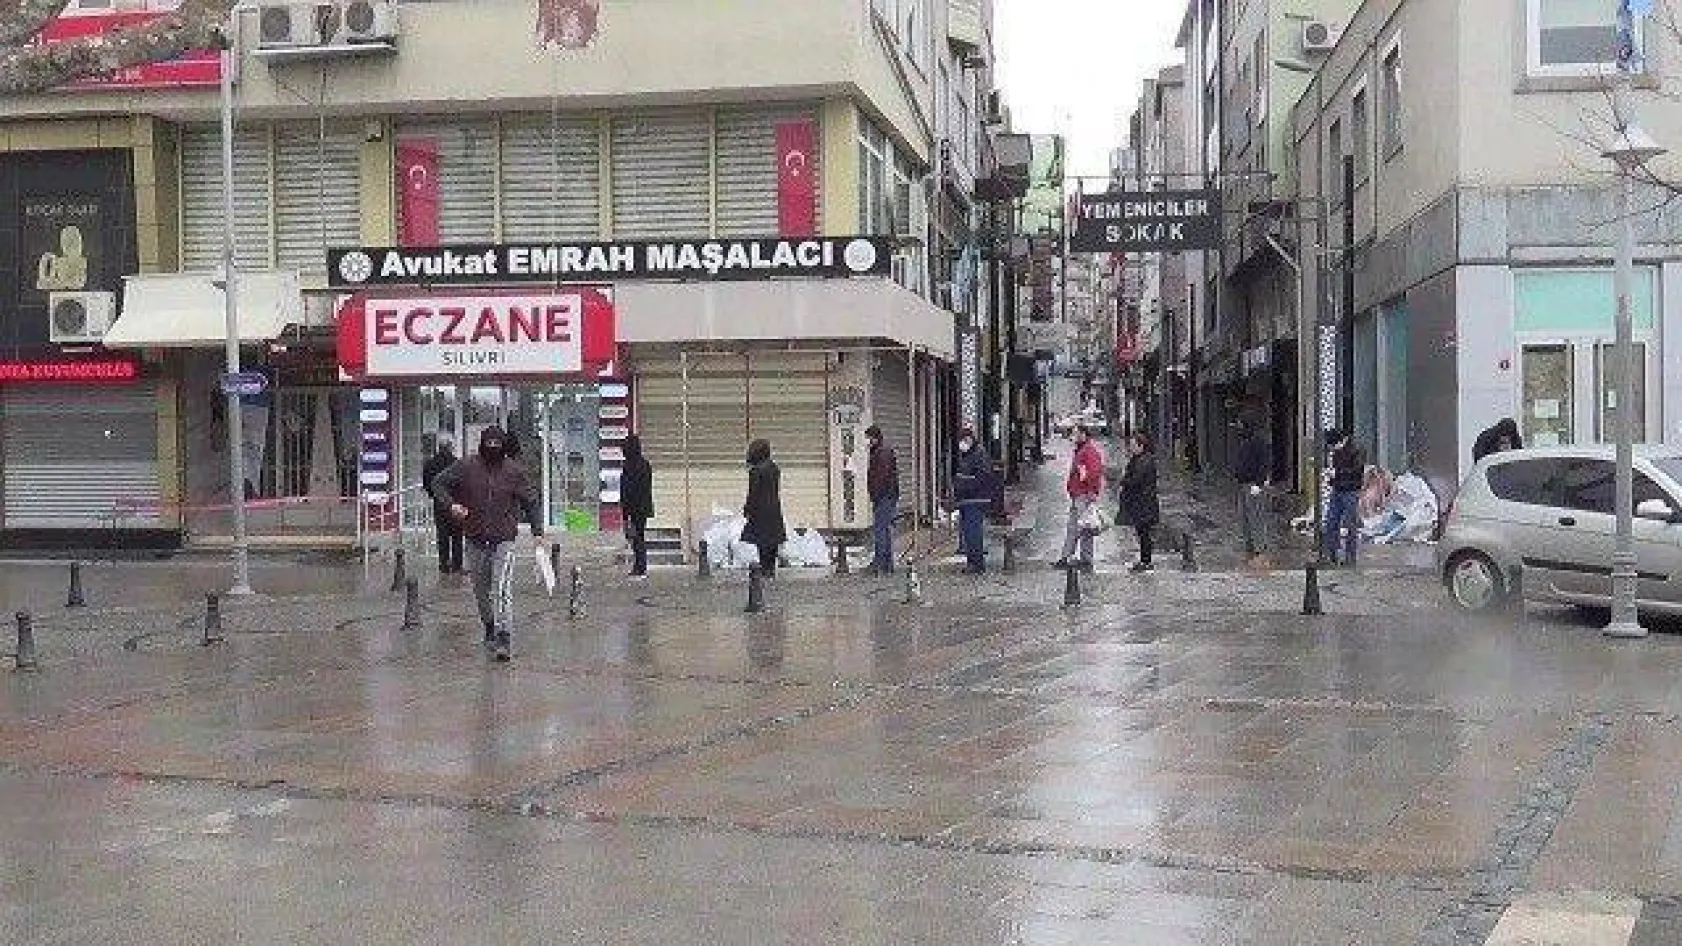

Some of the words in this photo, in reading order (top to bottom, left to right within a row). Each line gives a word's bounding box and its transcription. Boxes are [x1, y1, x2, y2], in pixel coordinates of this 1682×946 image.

[1105, 222, 1184, 243] SOKAK
[380, 250, 498, 277] Avukat
[508, 246, 635, 274] EMRAH
[646, 240, 834, 274] MAŞALACI
[374, 304, 572, 345] ECZANE
